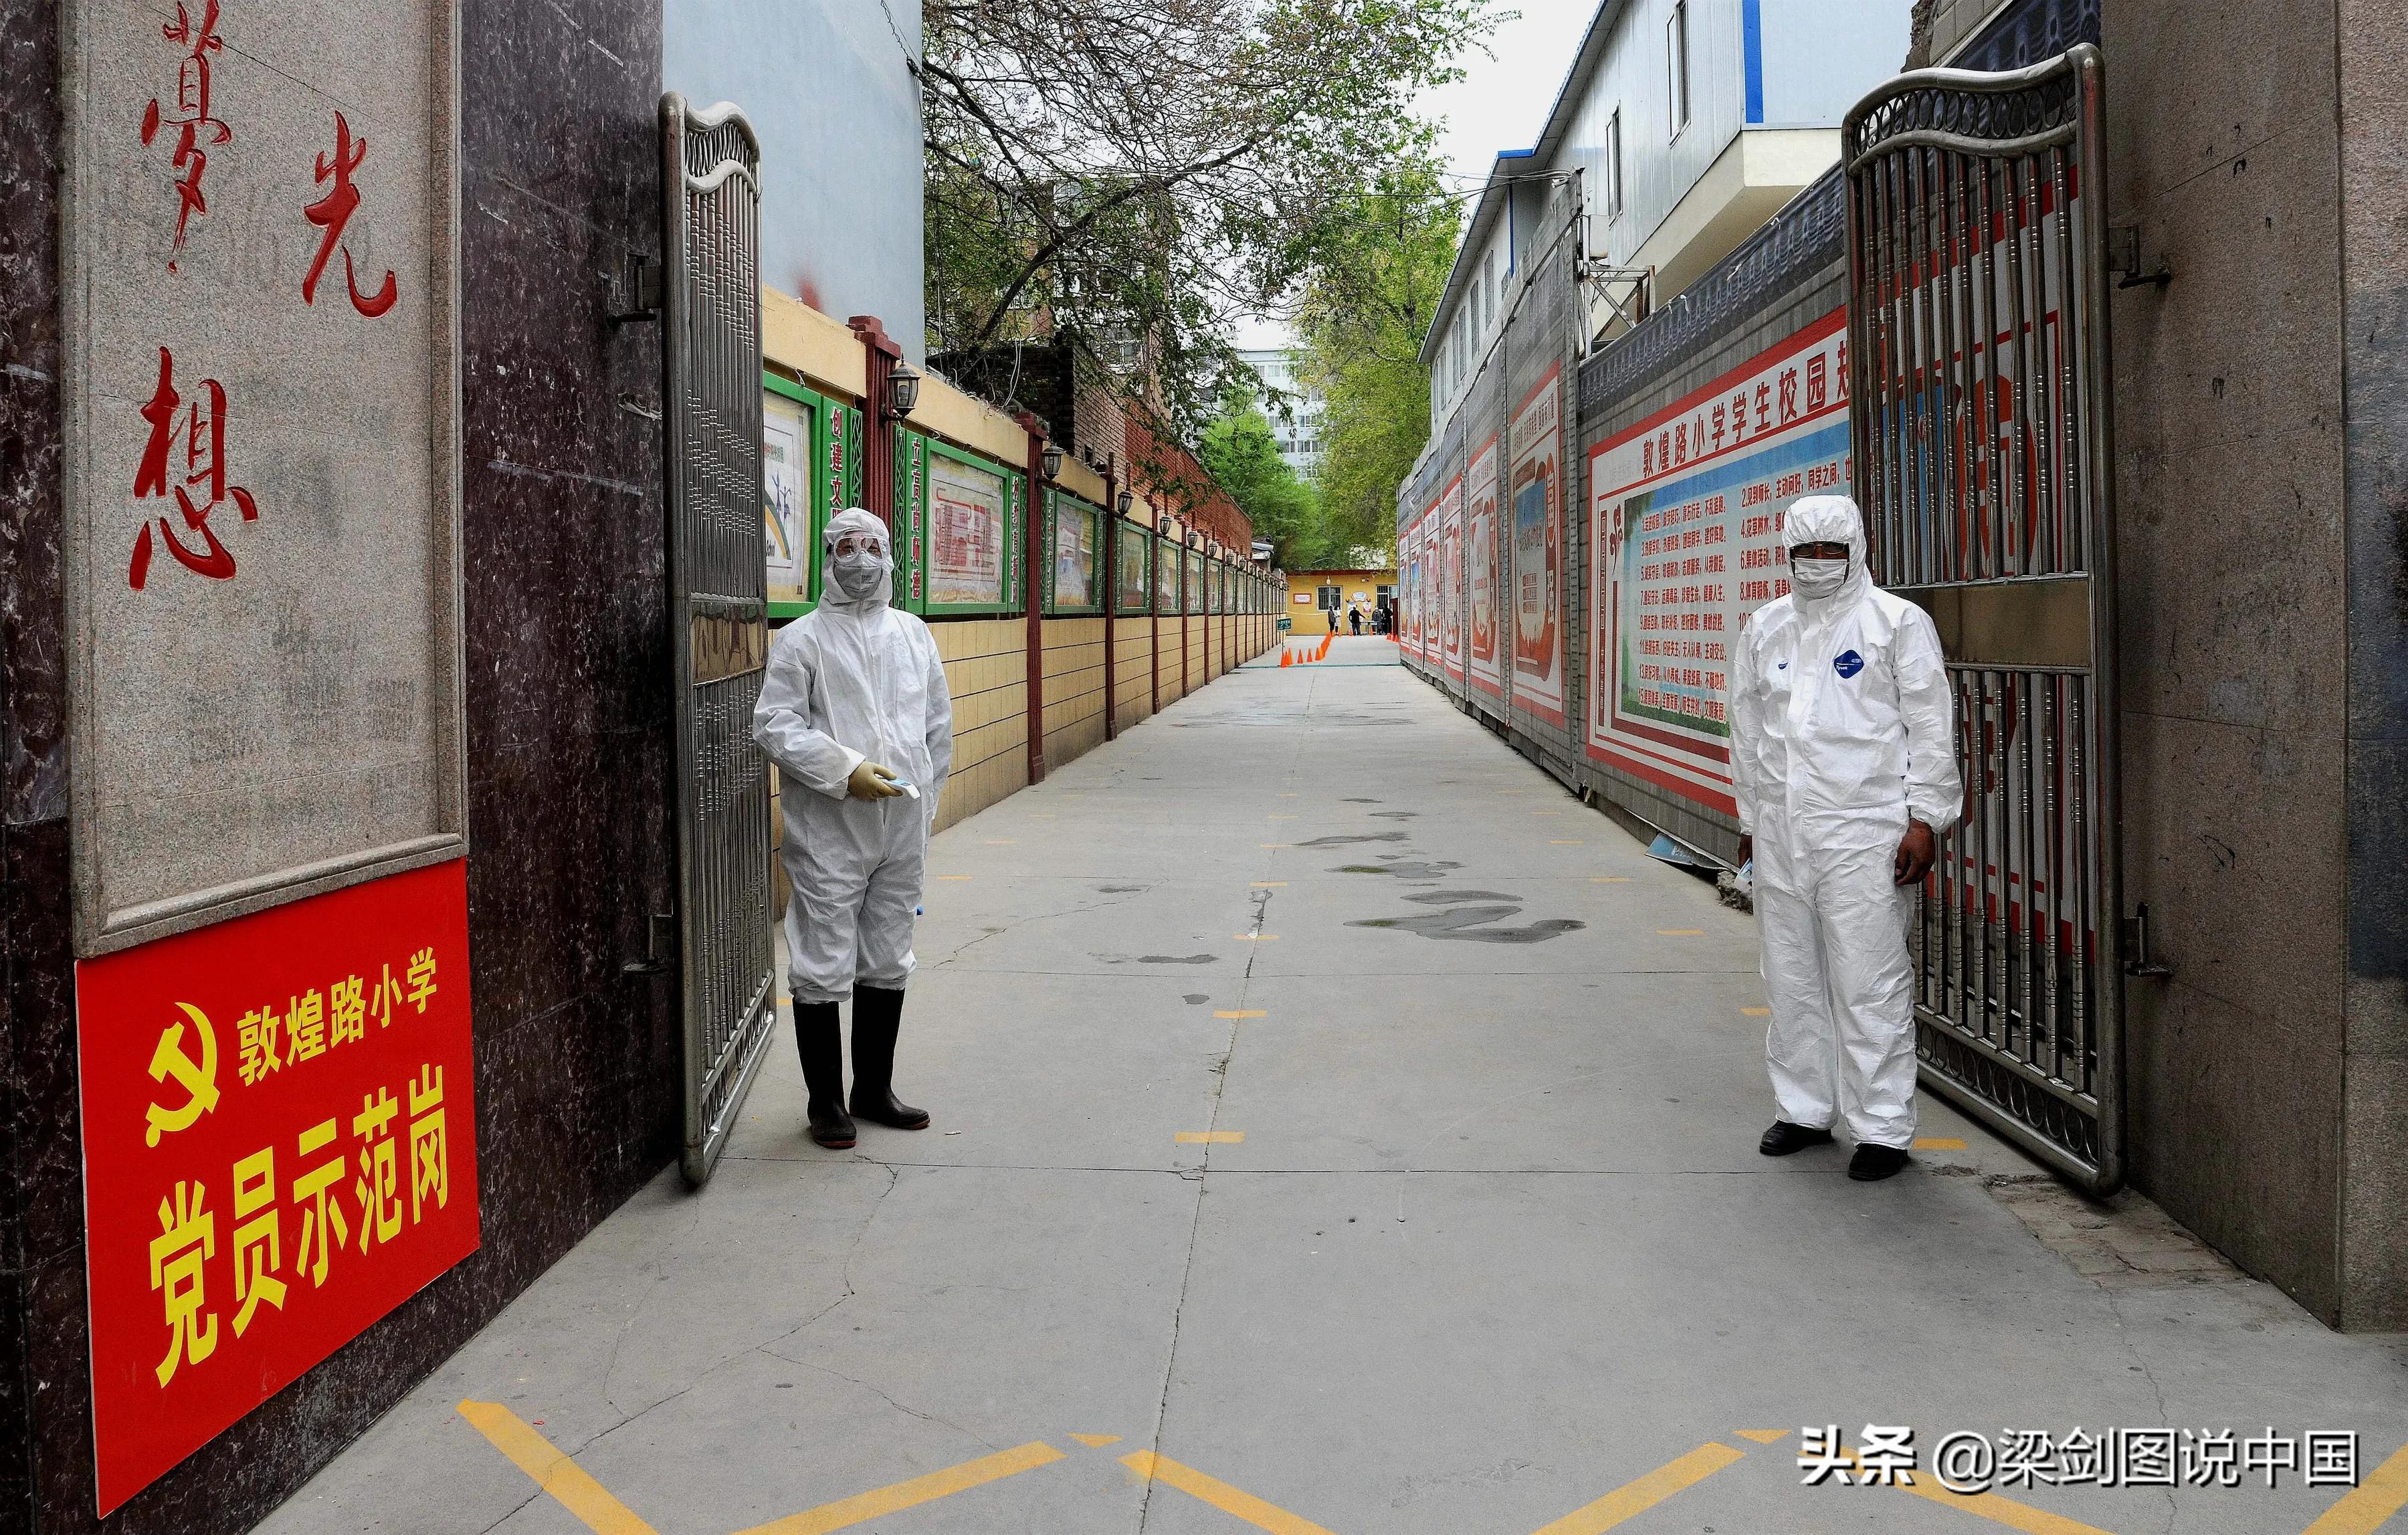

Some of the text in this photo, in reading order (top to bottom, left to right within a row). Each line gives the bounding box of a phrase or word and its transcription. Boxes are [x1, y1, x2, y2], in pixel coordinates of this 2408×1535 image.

[237, 946, 437, 1088] 敦煌路小学
[149, 1063, 448, 1389] 党员示范岗
